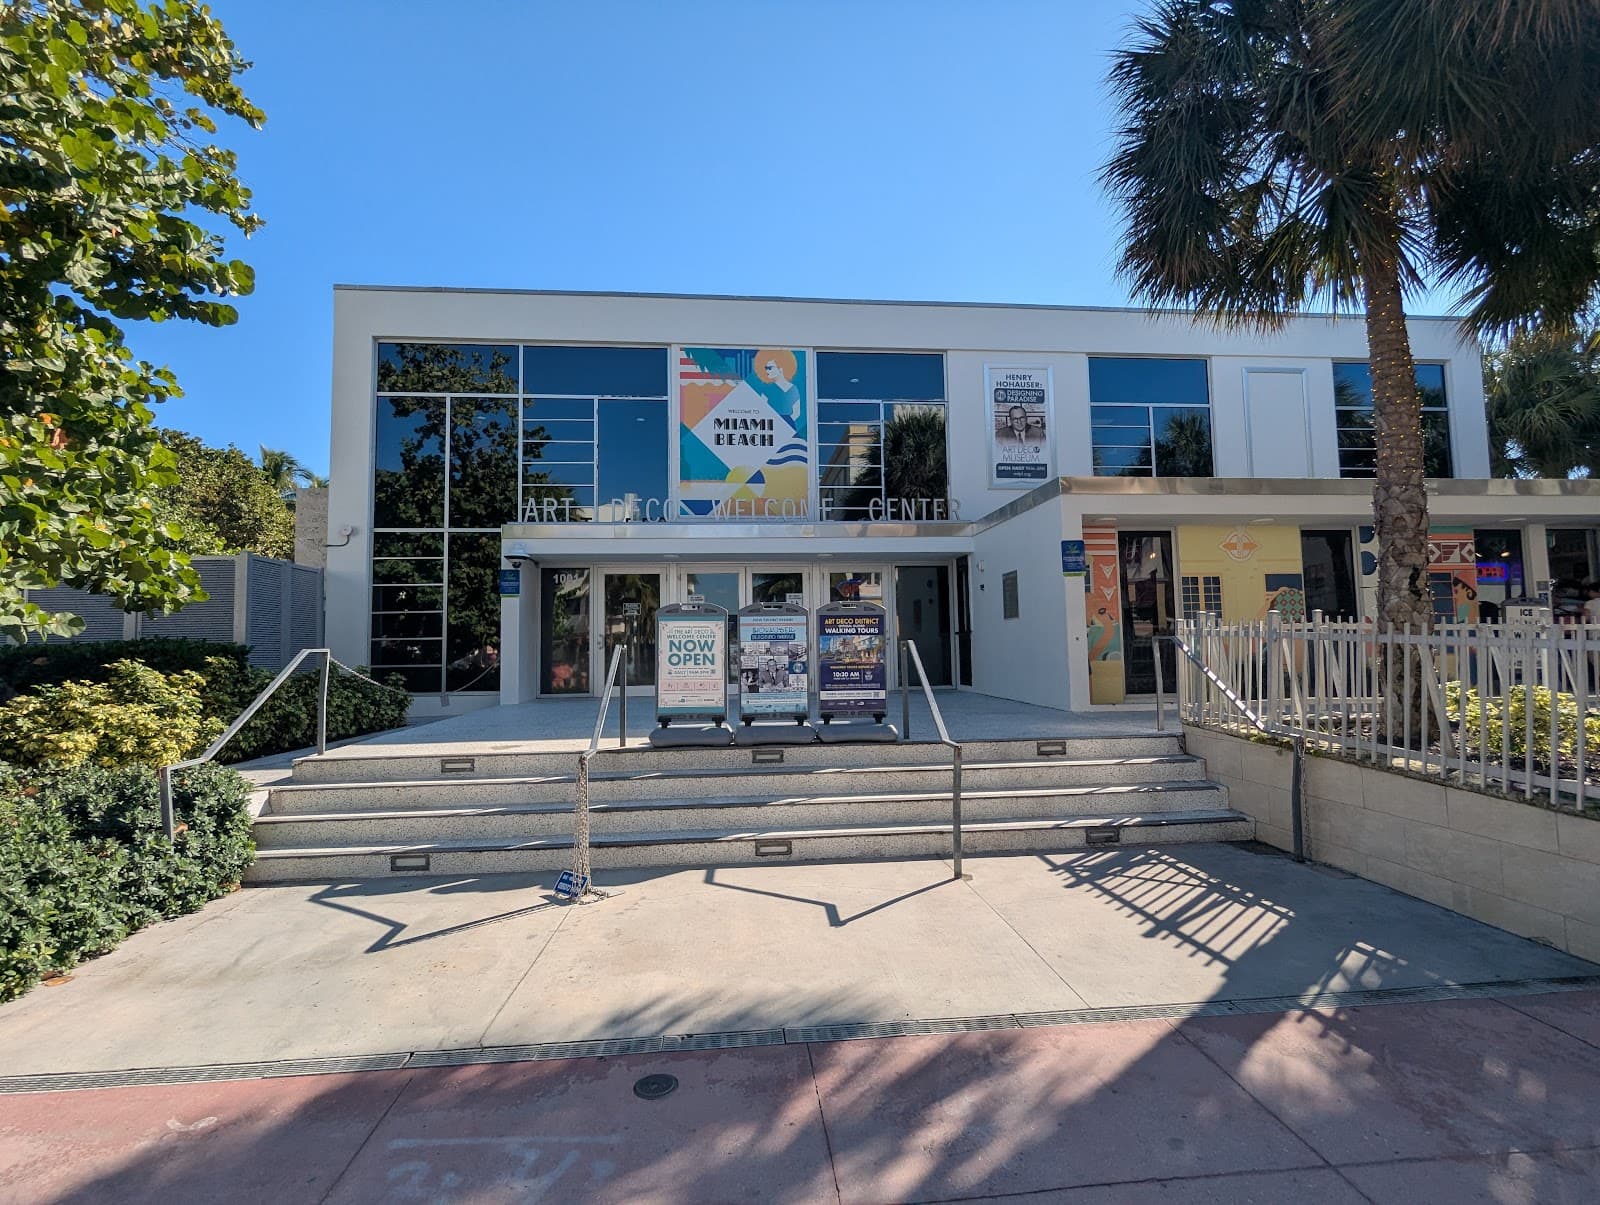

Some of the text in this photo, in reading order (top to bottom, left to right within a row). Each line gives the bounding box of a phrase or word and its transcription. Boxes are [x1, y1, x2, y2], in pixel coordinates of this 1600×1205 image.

[713, 418, 774, 431] MIAMI
[714, 433, 774, 446] BEACH
[1002, 454, 1041, 462] MUSEUM
[523, 497, 962, 523] ART DECO WELCOME CENTER
[552, 573, 580, 584] 1001
[855, 617, 880, 625] DISTRICT
[669, 640, 716, 653] NOW
[668, 653, 716, 666] OPEN
